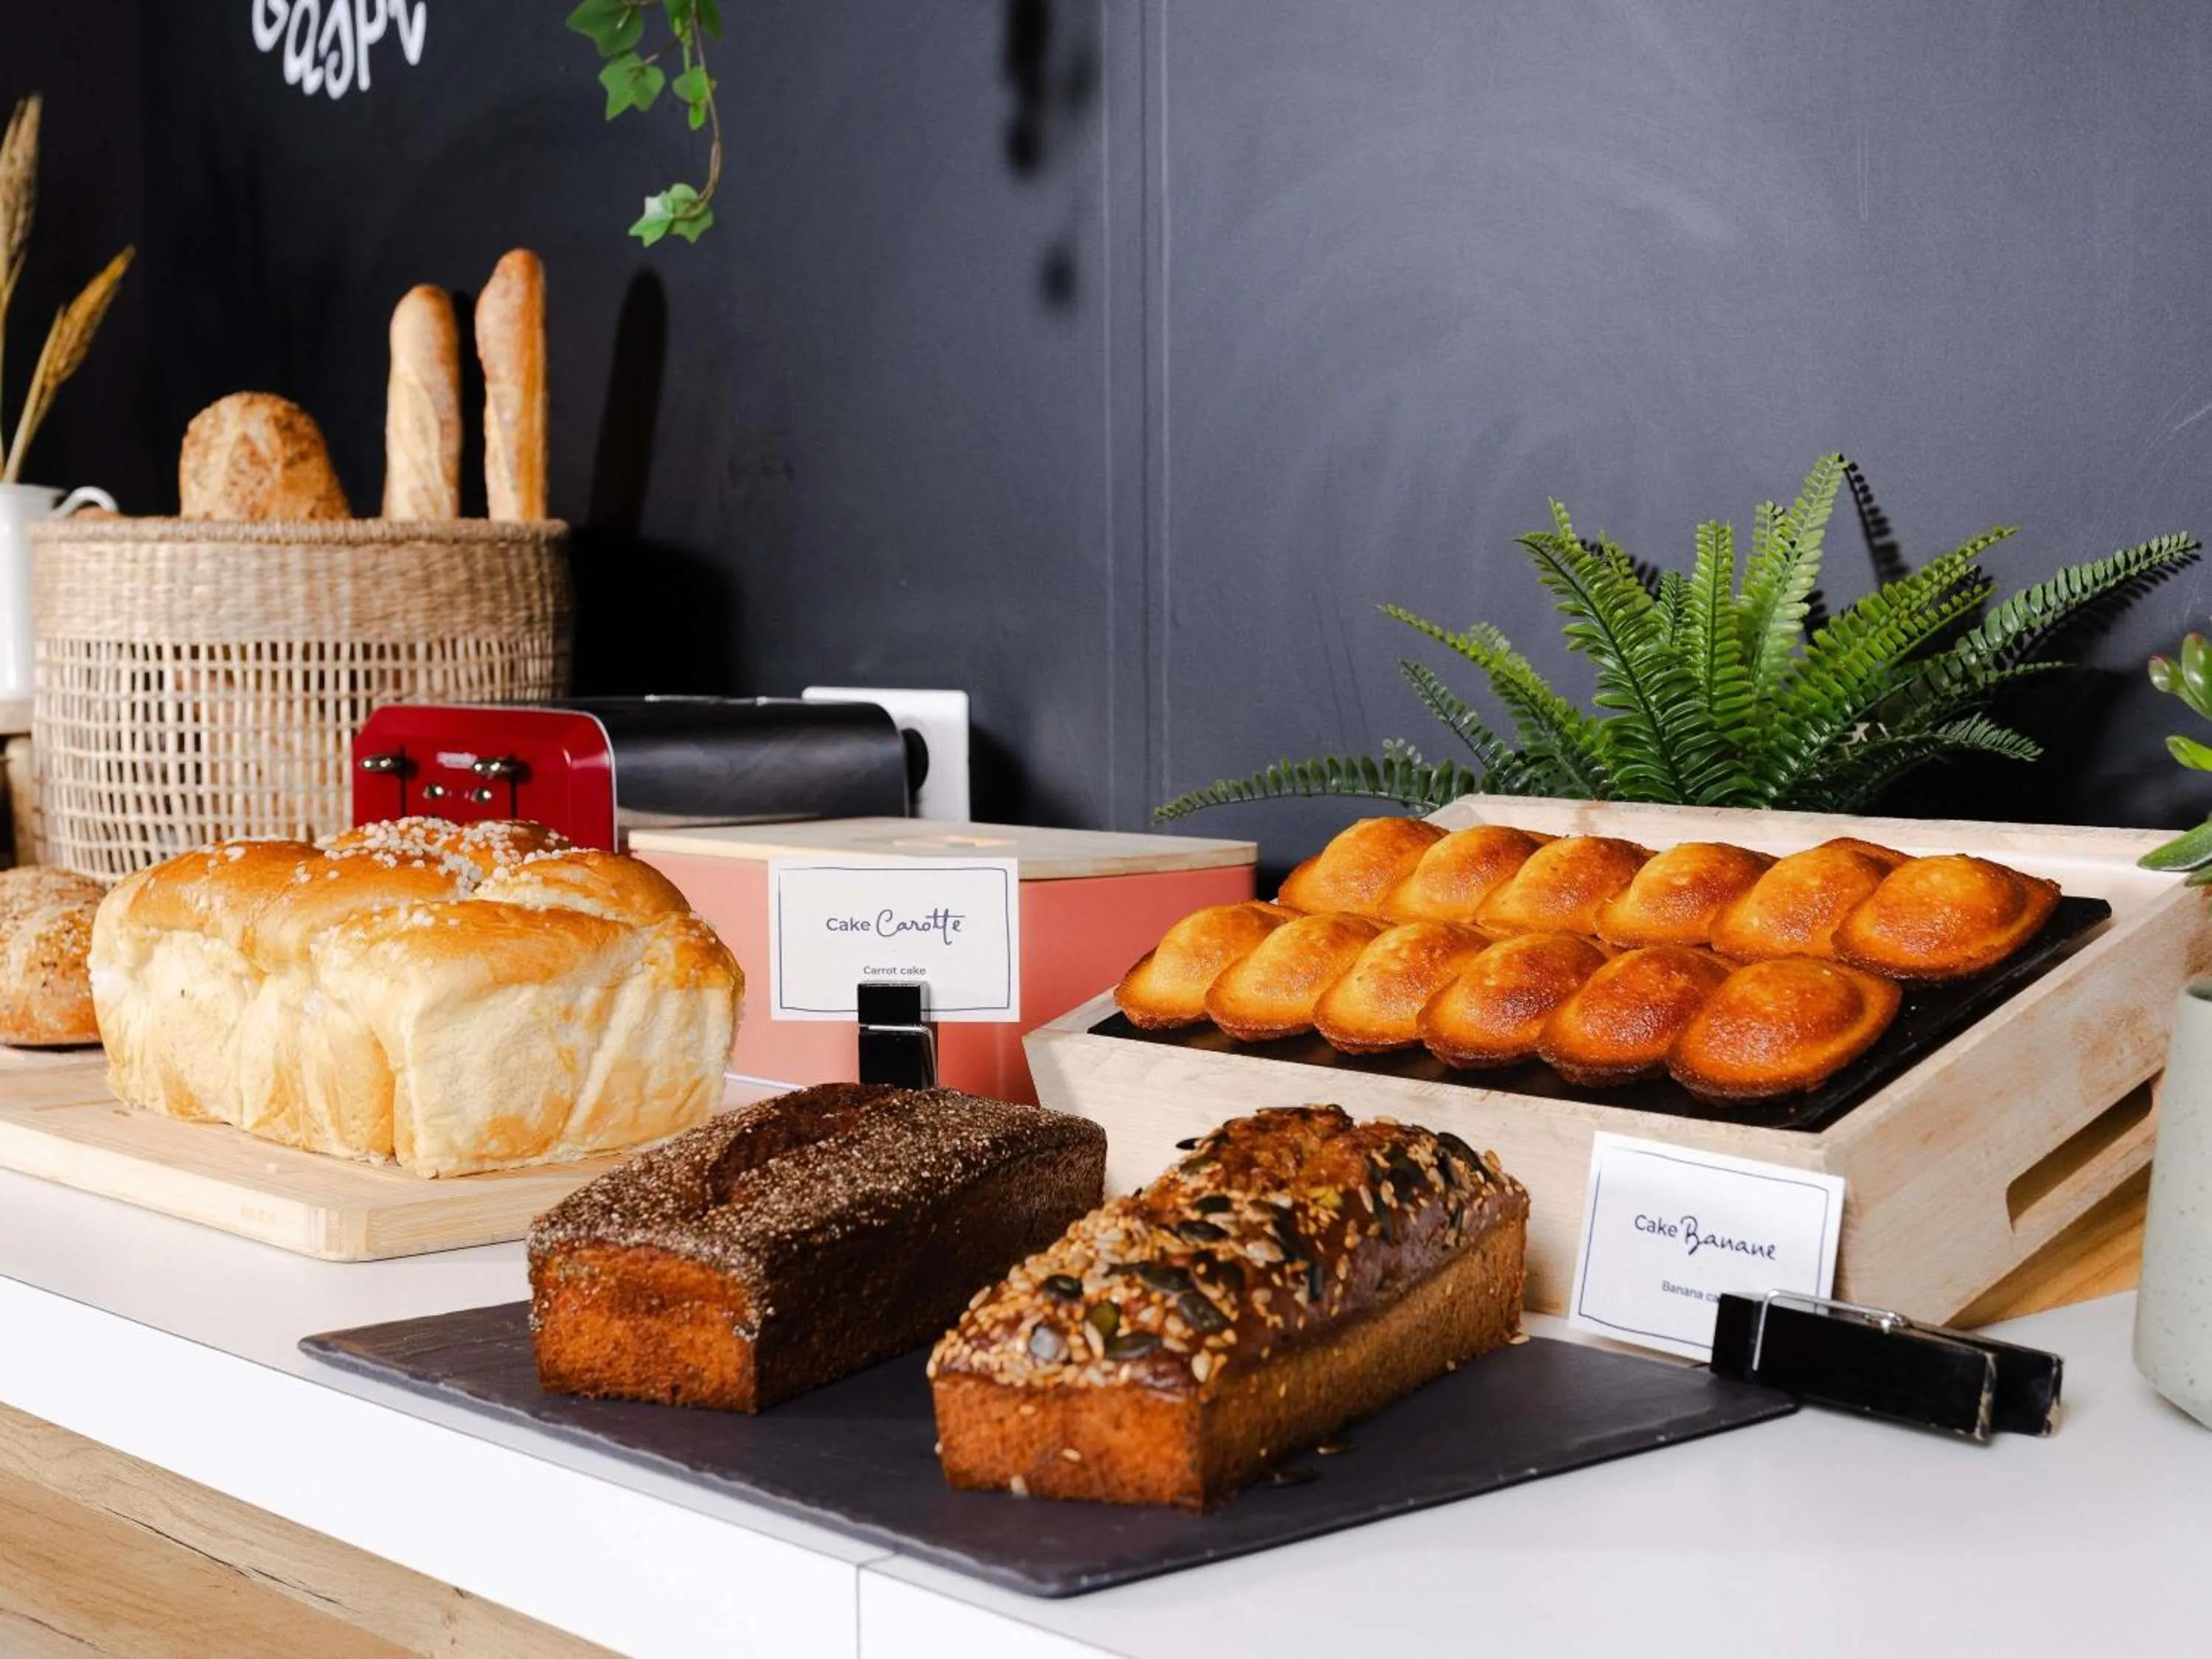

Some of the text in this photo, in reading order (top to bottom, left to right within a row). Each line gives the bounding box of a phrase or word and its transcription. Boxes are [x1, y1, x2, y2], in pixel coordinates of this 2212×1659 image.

[826, 908, 966, 946] Cake Carotte
[863, 965, 926, 975] Carrot cake
[1634, 1214, 1777, 1261] Cake Banane
[1662, 1279, 1721, 1304] Banana ca
